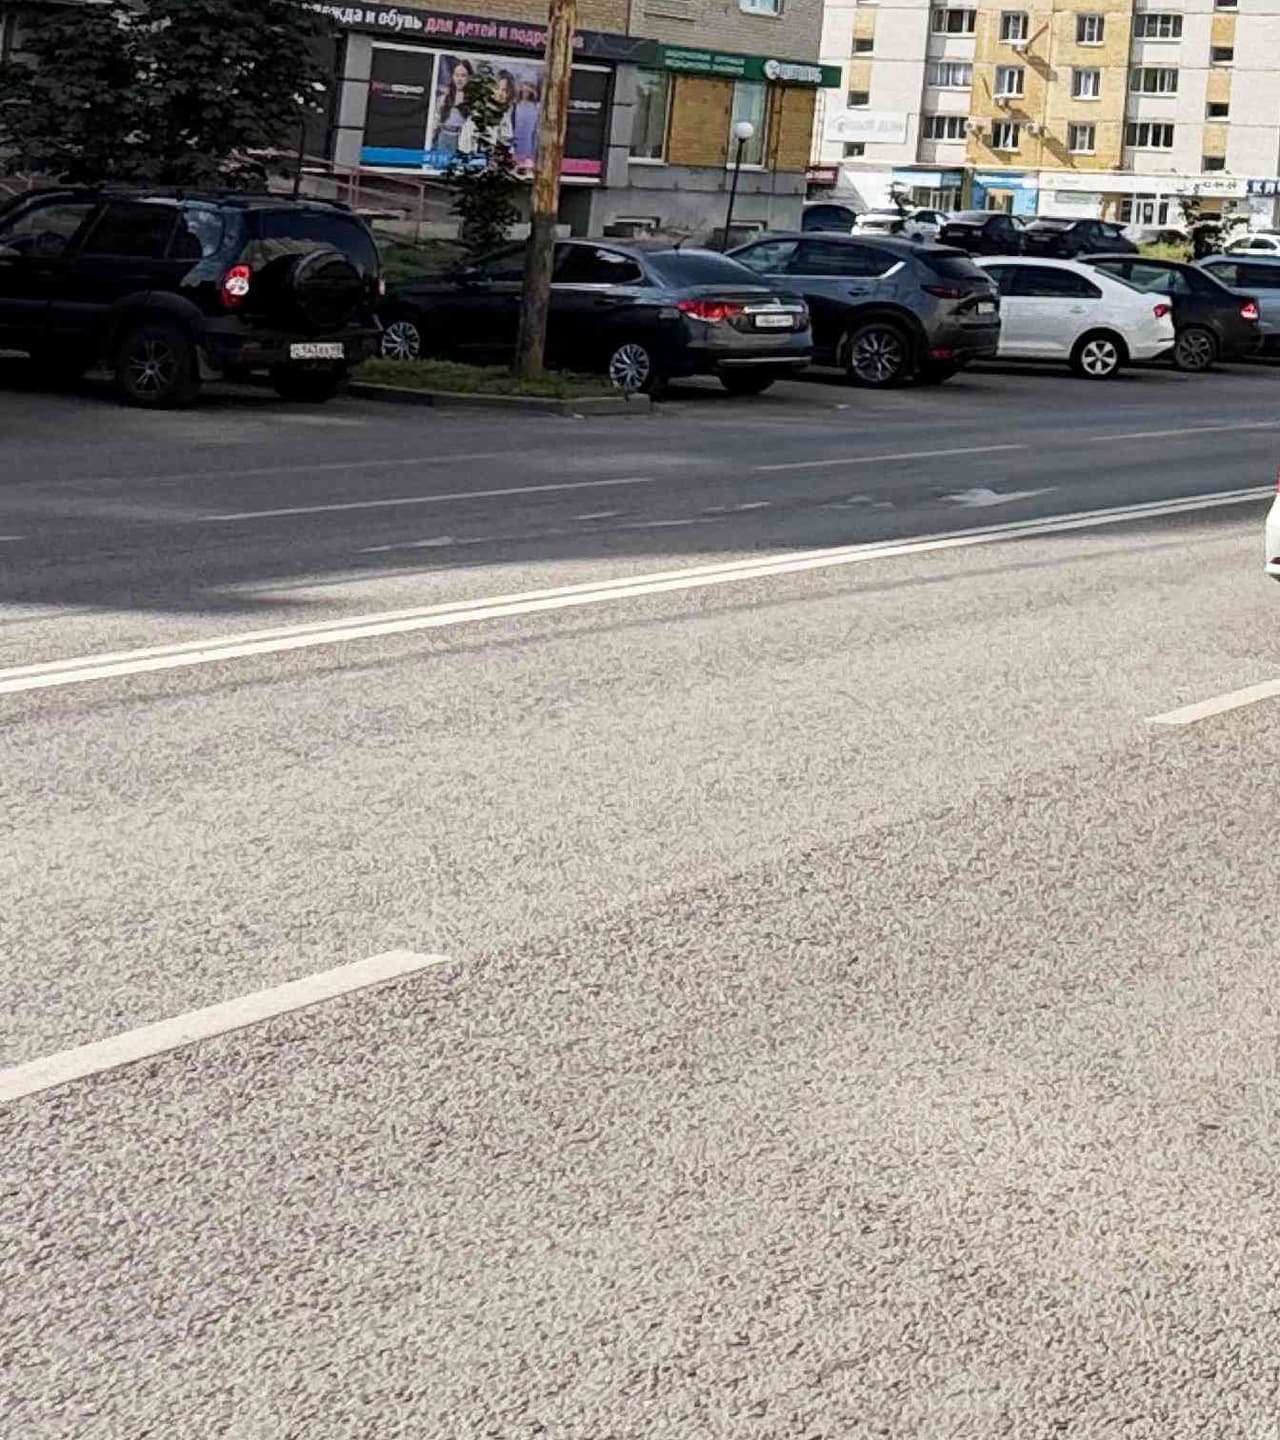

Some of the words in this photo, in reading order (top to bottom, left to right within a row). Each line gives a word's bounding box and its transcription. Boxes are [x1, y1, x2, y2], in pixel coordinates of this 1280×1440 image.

[366, 10, 375, 23] и
[378, 9, 423, 31] обувь
[425, 17, 454, 34] для
[455, 20, 497, 38] детей
[499, 26, 508, 40] и
